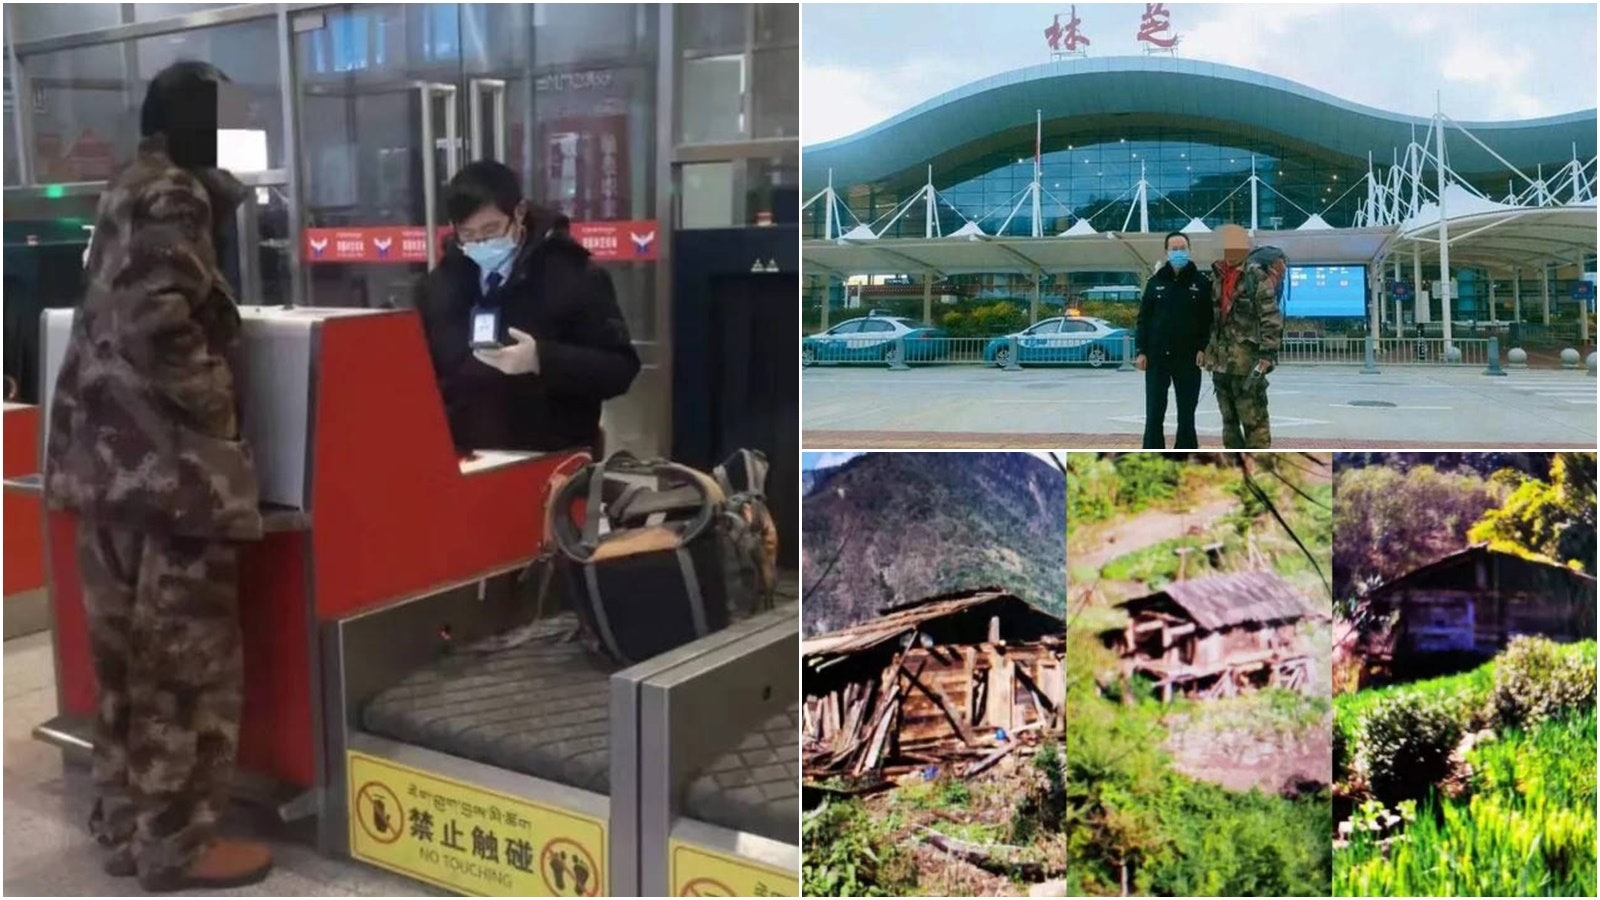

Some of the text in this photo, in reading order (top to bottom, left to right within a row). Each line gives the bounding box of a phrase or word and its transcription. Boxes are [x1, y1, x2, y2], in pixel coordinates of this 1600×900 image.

[409, 808, 534, 874] 禁止触碰
[419, 847, 513, 888] NO TOUCHING
